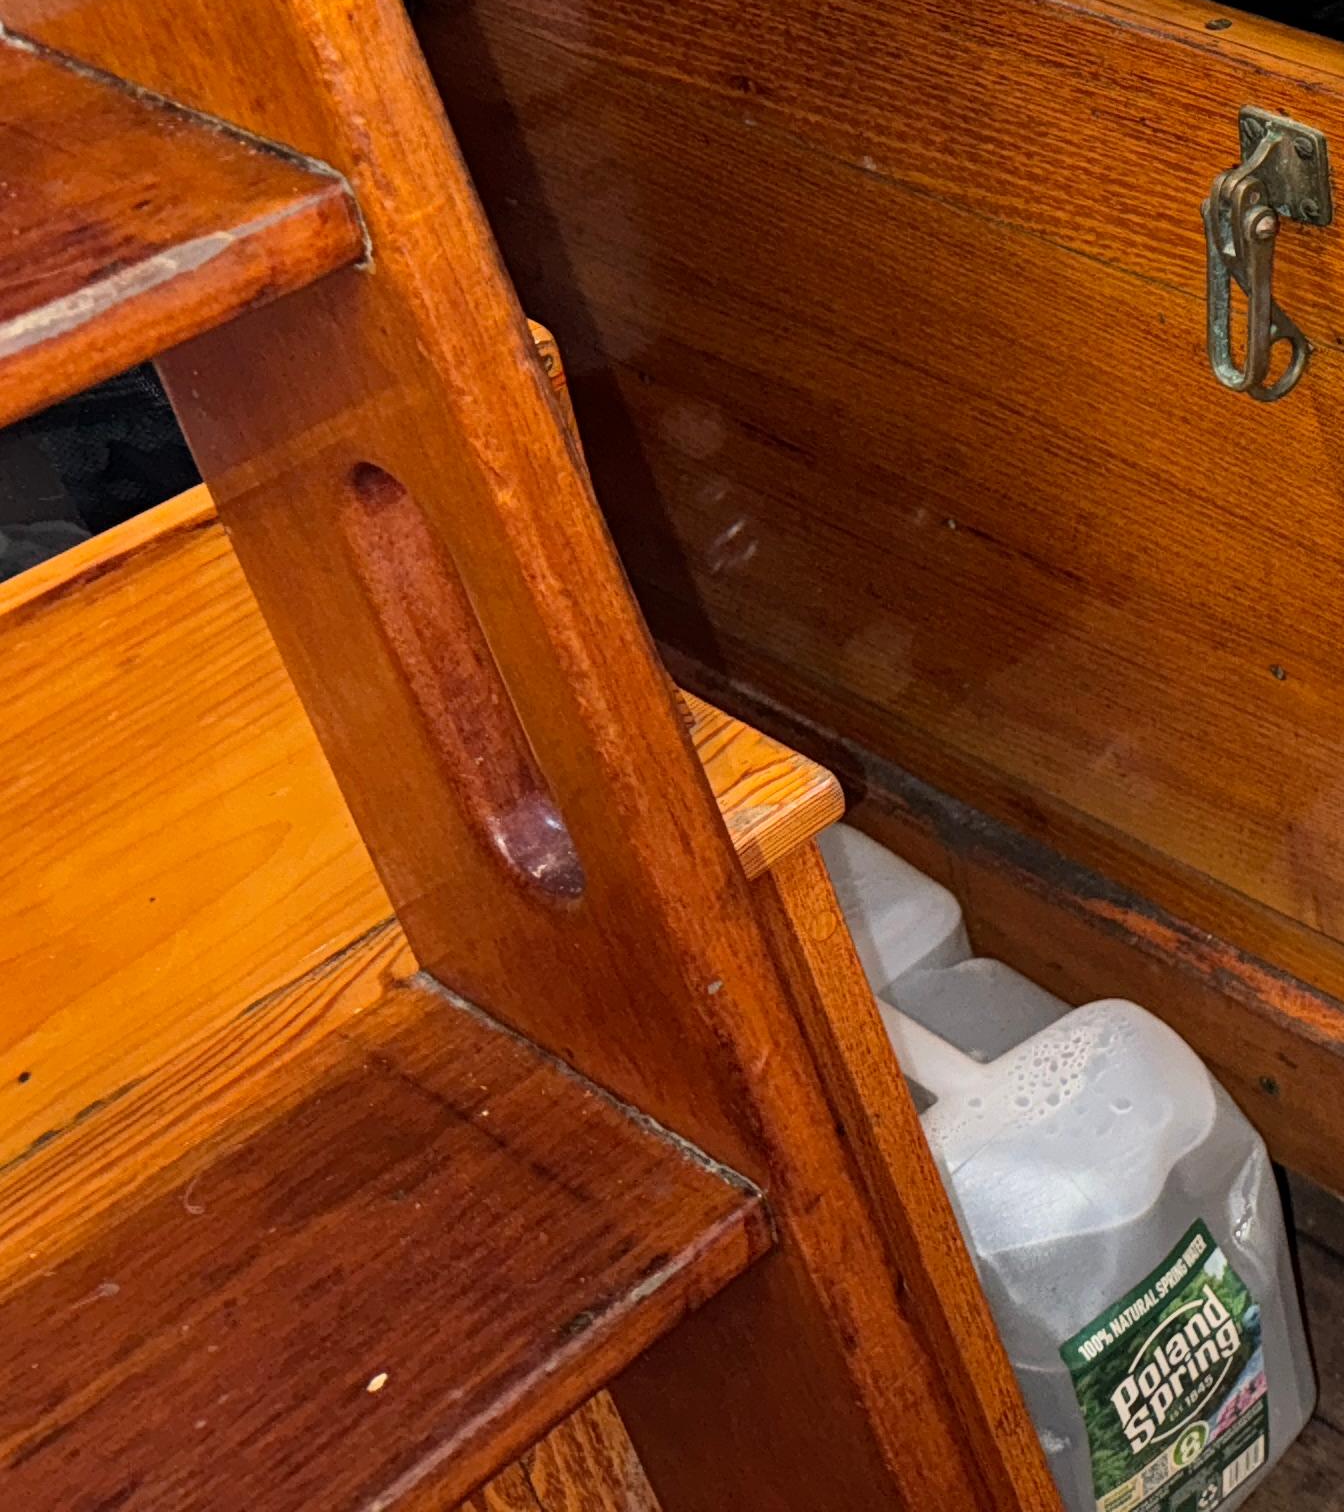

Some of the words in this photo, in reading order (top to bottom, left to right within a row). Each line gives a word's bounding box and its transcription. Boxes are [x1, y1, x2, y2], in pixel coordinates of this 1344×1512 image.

[1077, 1327, 1114, 1362] 100%
[1109, 1288, 1160, 1339] NATURAL
[1155, 1257, 1189, 1300] SPRING
[1110, 1284, 1231, 1429] Poland
[1123, 1319, 1242, 1455] Spring
